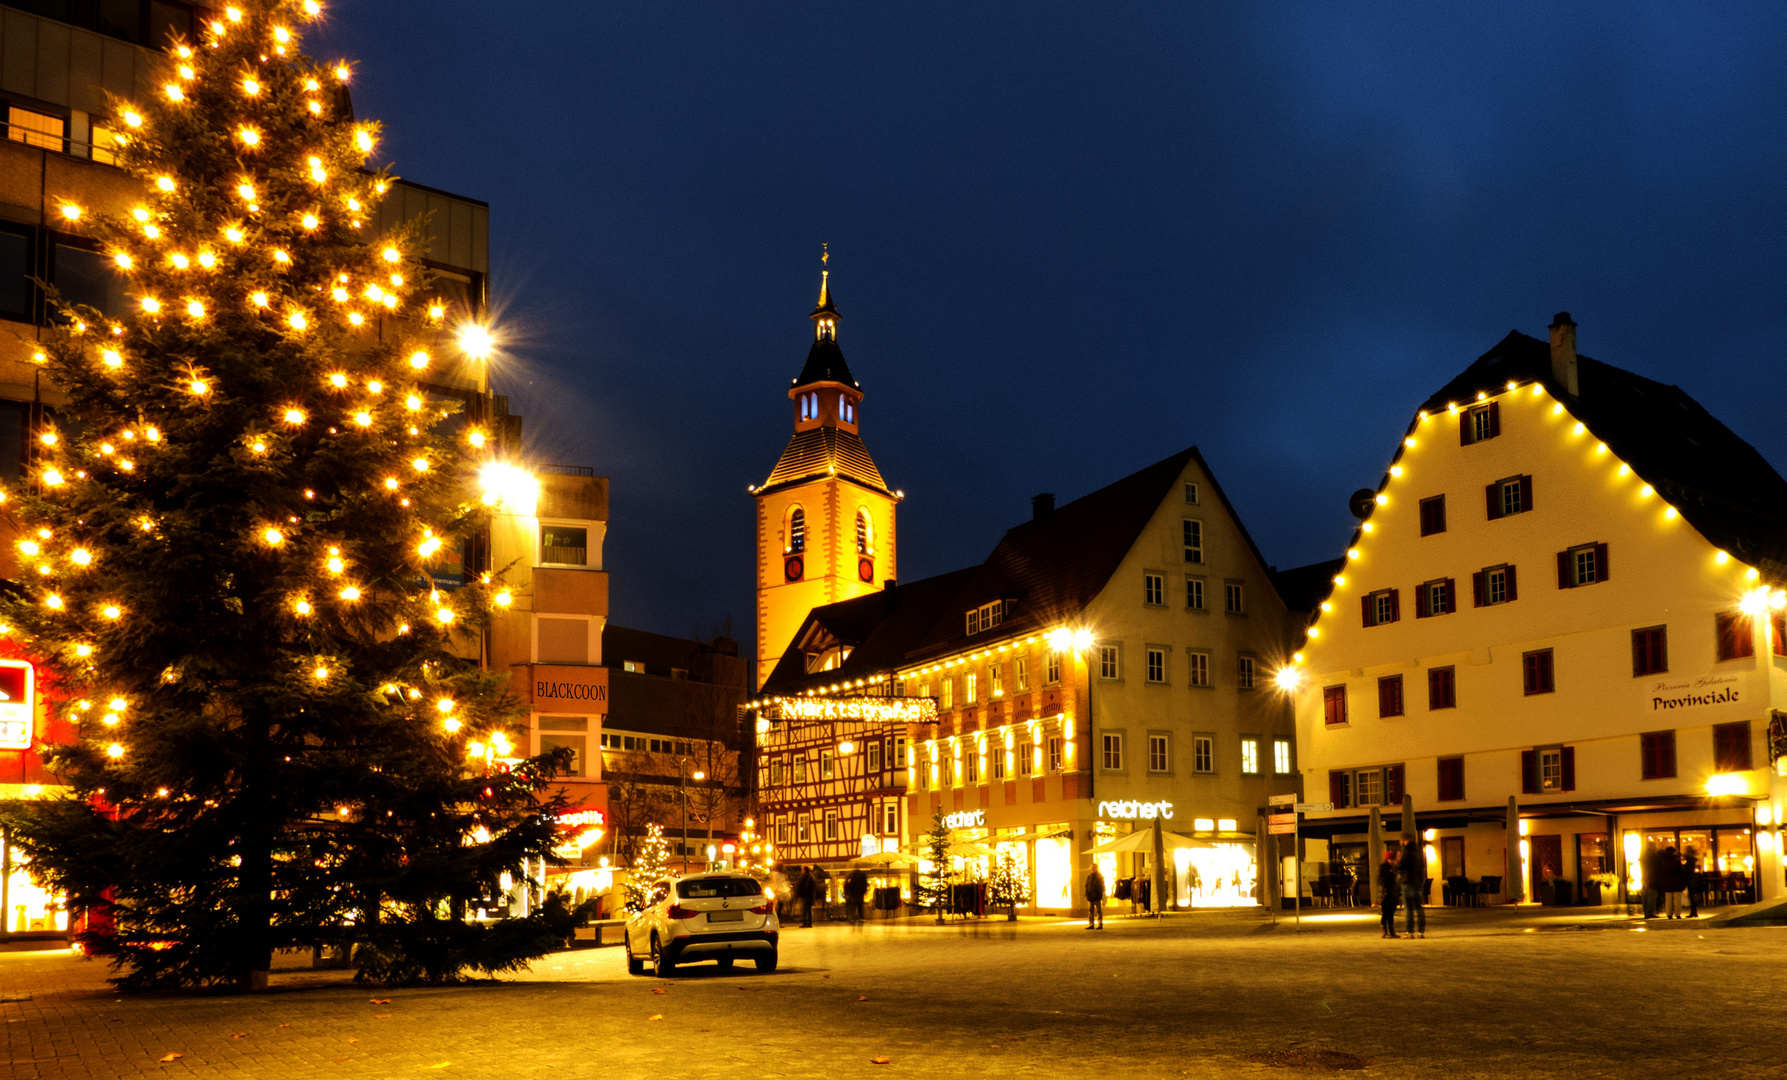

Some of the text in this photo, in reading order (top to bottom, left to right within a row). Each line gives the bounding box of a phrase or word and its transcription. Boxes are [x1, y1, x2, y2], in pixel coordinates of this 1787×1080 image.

[537, 681, 606, 701] BLACKCOON
[1652, 677, 1738, 692] Pizzeria Gelateria
[783, 699, 920, 718] Marktstraße
[1653, 687, 1739, 710] Provinciale
[942, 809, 985, 829] reichert
[1098, 799, 1174, 819] reichert
